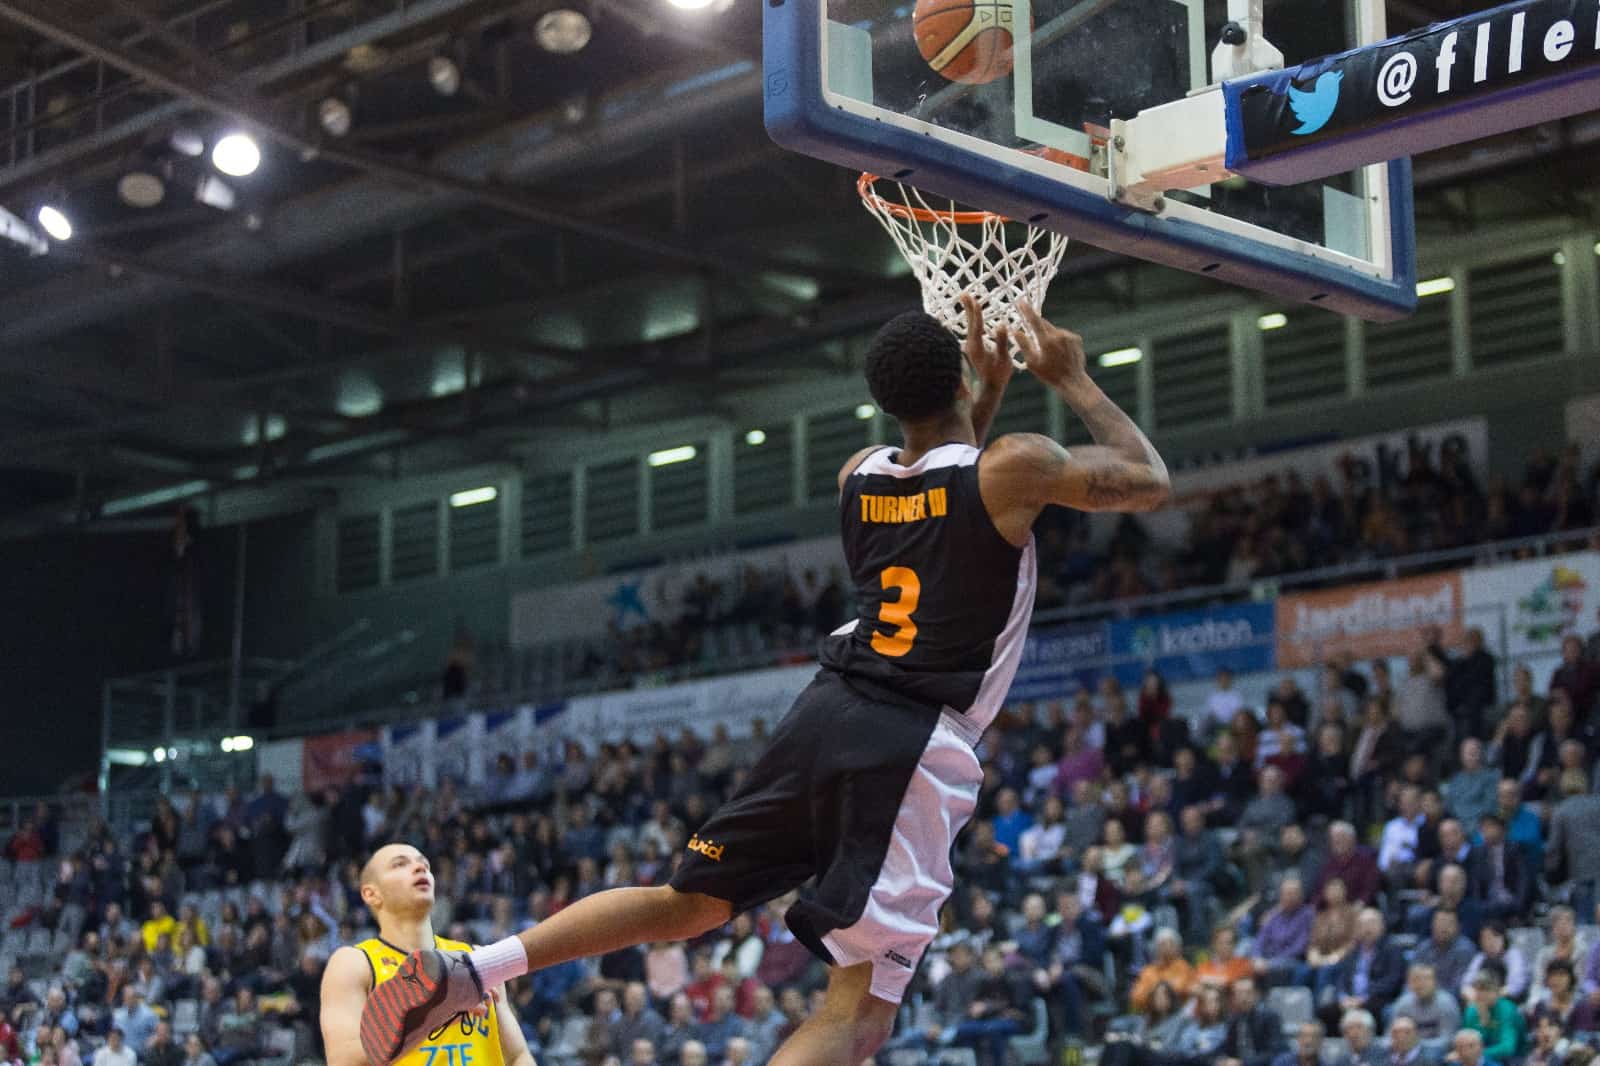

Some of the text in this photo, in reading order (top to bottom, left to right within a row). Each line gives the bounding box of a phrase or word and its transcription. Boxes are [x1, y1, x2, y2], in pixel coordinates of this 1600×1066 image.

[1377, 0, 1600, 107] @flle
[860, 487, 947, 523] TURNER III
[870, 566, 921, 657] 3
[420, 1043, 473, 1066] ZTE
